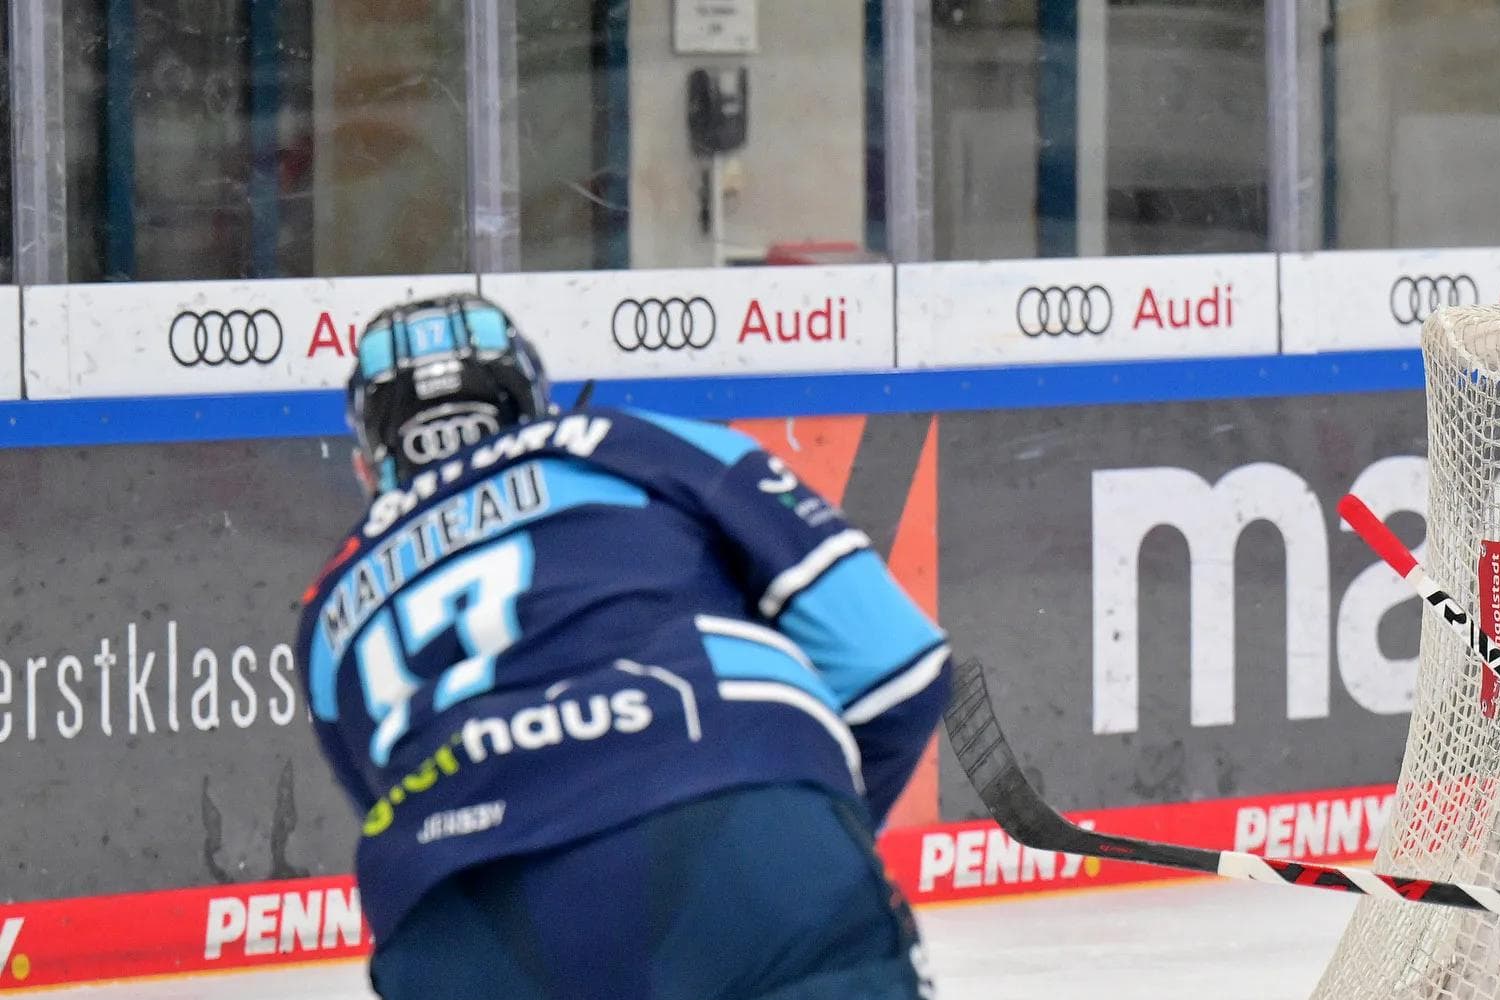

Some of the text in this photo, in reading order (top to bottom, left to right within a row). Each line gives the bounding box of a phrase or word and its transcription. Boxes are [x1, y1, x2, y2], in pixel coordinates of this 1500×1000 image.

[738, 297, 846, 344] Audi
[1134, 286, 1234, 330] Audi
[321, 459, 551, 652] MATTEAU
[354, 528, 536, 768] 17
[203, 885, 375, 961] PENN
